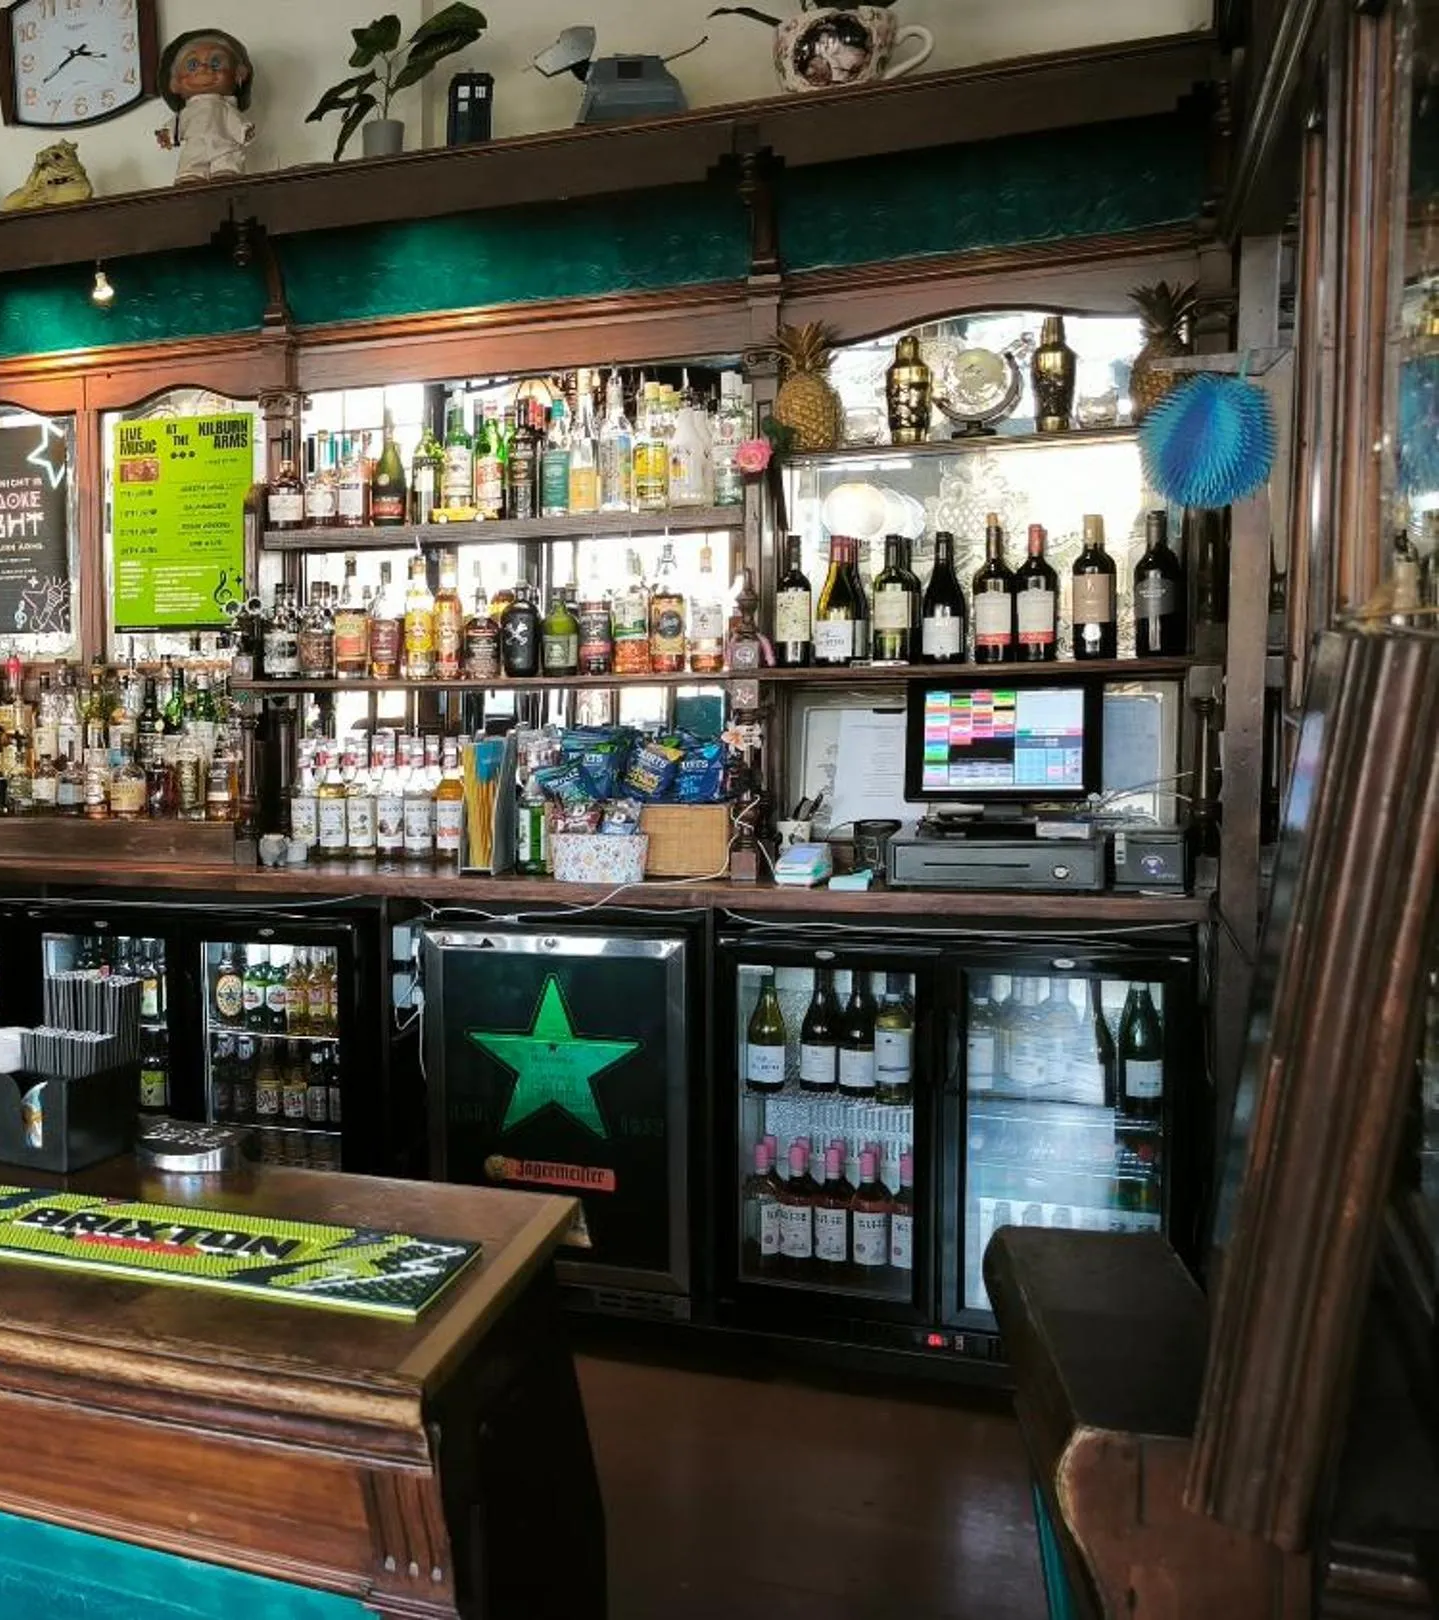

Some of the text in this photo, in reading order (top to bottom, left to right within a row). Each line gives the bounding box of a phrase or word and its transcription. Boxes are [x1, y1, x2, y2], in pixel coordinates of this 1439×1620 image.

[20, 22, 37, 42] 10
[122, 32, 135, 52] 3
[21, 54, 35, 73] 9
[123, 67, 135, 85] 4
[74, 97, 88, 116] 6
[120, 427, 142, 441] LIVE
[166, 424, 177, 434] AT
[199, 419, 248, 436] KILBURN
[120, 439, 157, 455] MUSIC
[214, 433, 248, 449] ARMS
[0, 478, 30, 489] NIGHT
[13, 1206, 301, 1260] BRIXTON
